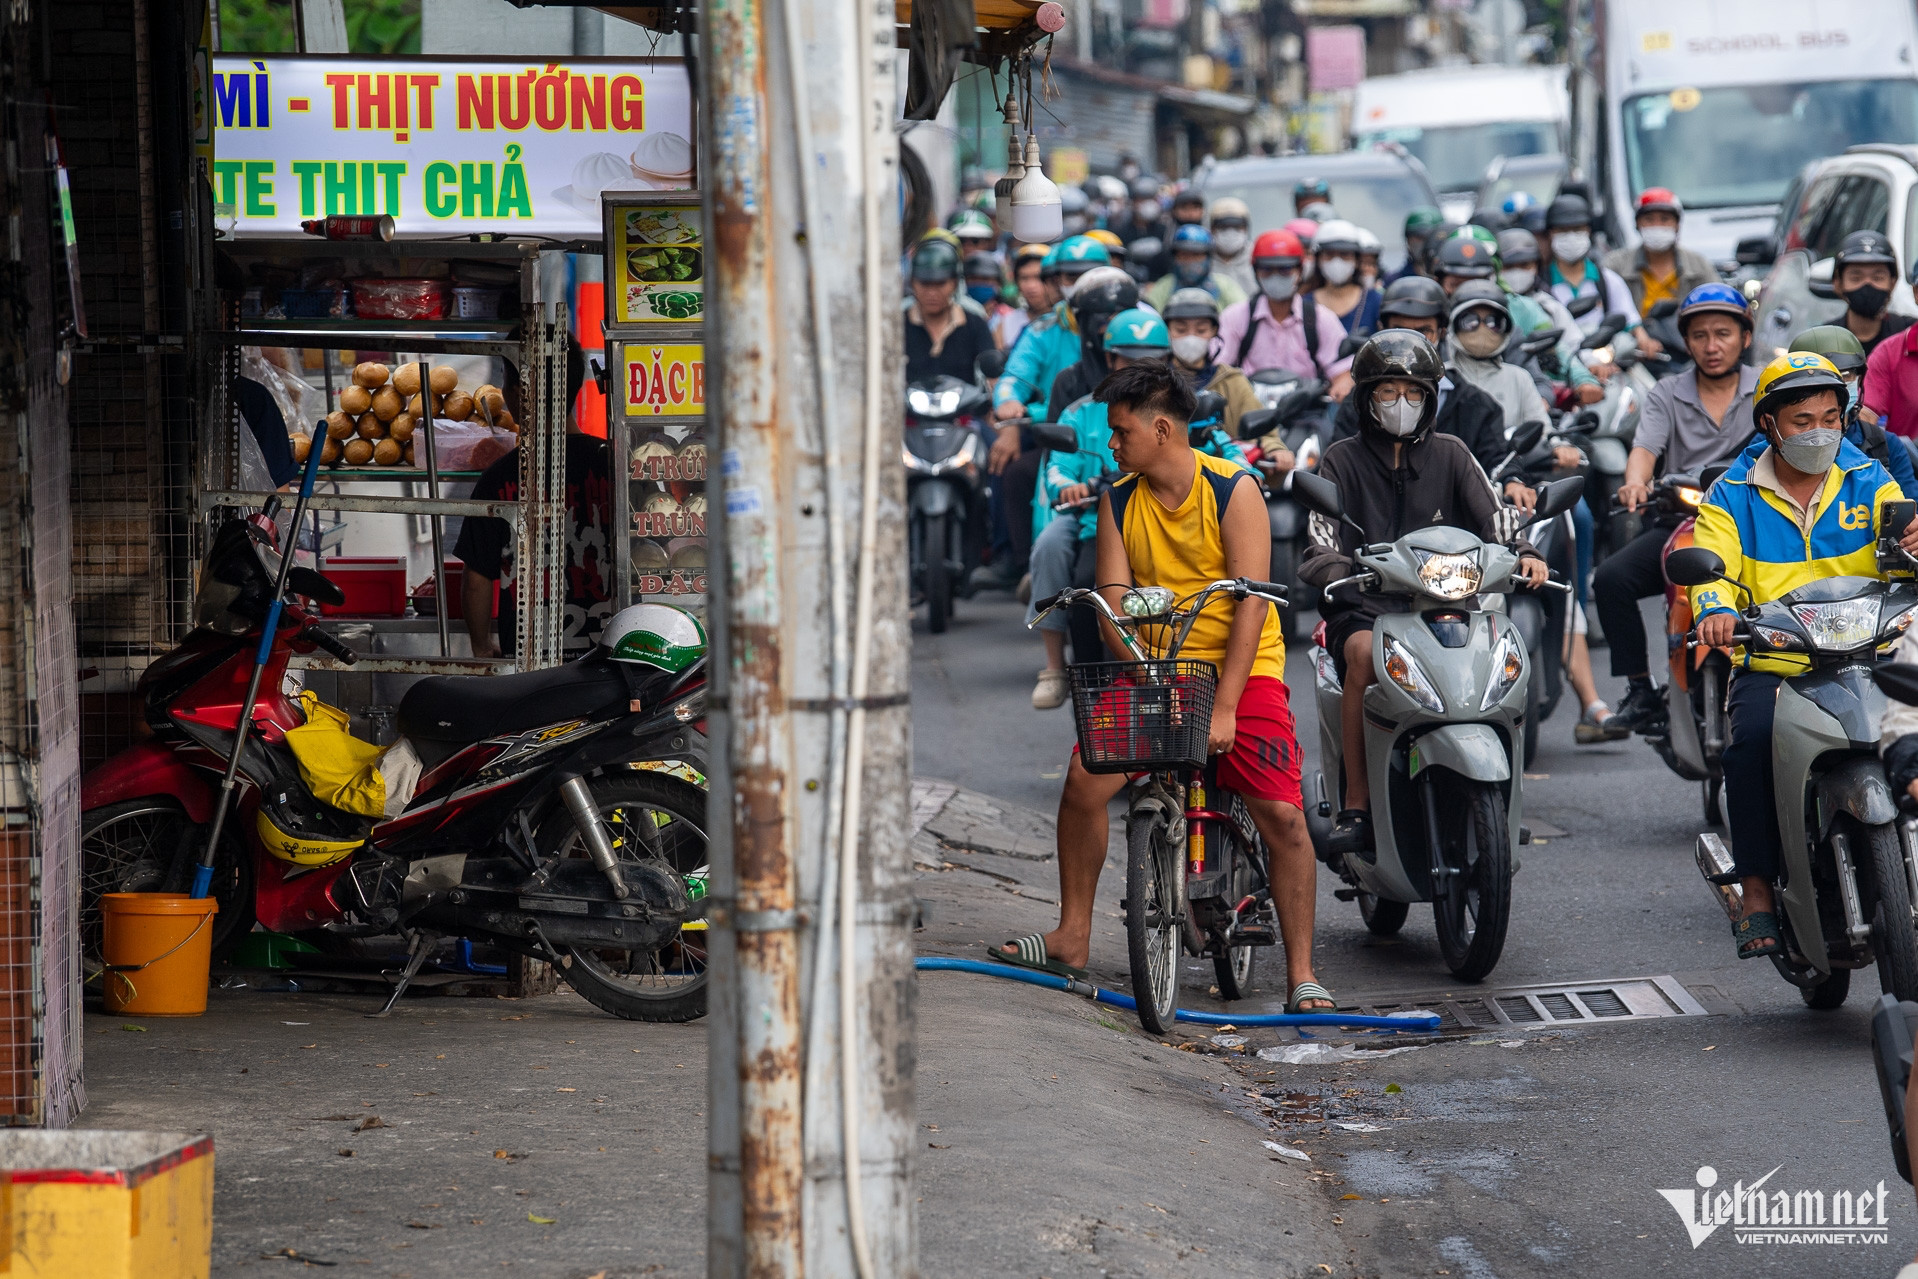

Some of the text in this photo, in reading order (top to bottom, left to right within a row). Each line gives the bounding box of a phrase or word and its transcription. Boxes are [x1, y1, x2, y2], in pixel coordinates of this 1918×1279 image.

[1687, 33, 1789, 56] SCHOOL
[1797, 28, 1850, 49] BUS
[213, 60, 270, 129] MÌ
[325, 73, 441, 143] THỊT
[456, 63, 645, 132] NƯỚNG
[213, 160, 276, 217] TE
[424, 142, 533, 218] CHẢ
[1787, 356, 1820, 369] be
[628, 349, 686, 414] ĐẶC
[1839, 501, 1871, 531] be
[1837, 665, 1873, 675] HONDA
